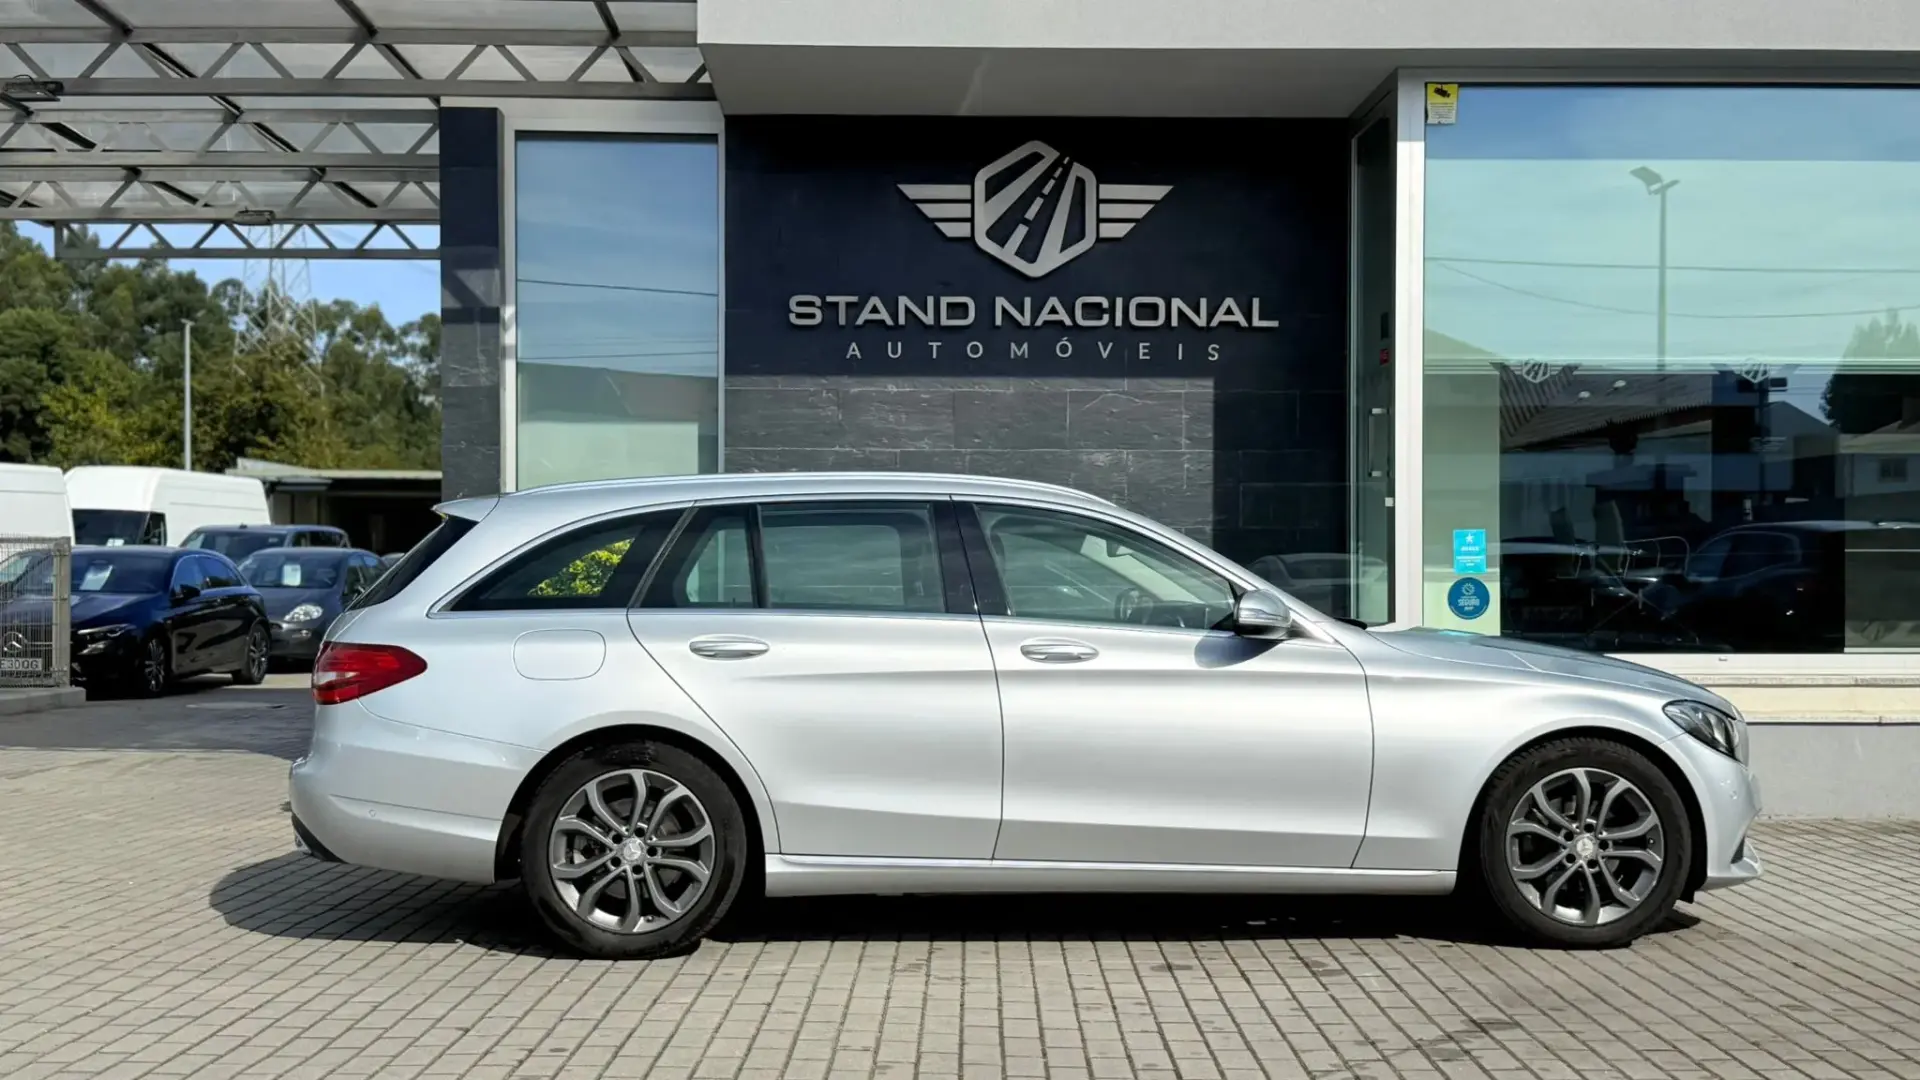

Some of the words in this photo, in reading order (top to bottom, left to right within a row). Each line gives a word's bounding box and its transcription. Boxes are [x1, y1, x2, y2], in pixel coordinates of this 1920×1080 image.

[788, 295, 976, 326] STAND
[995, 296, 1279, 328] NACIONAL
[846, 336, 1220, 361] AUTOMÓVEIS
